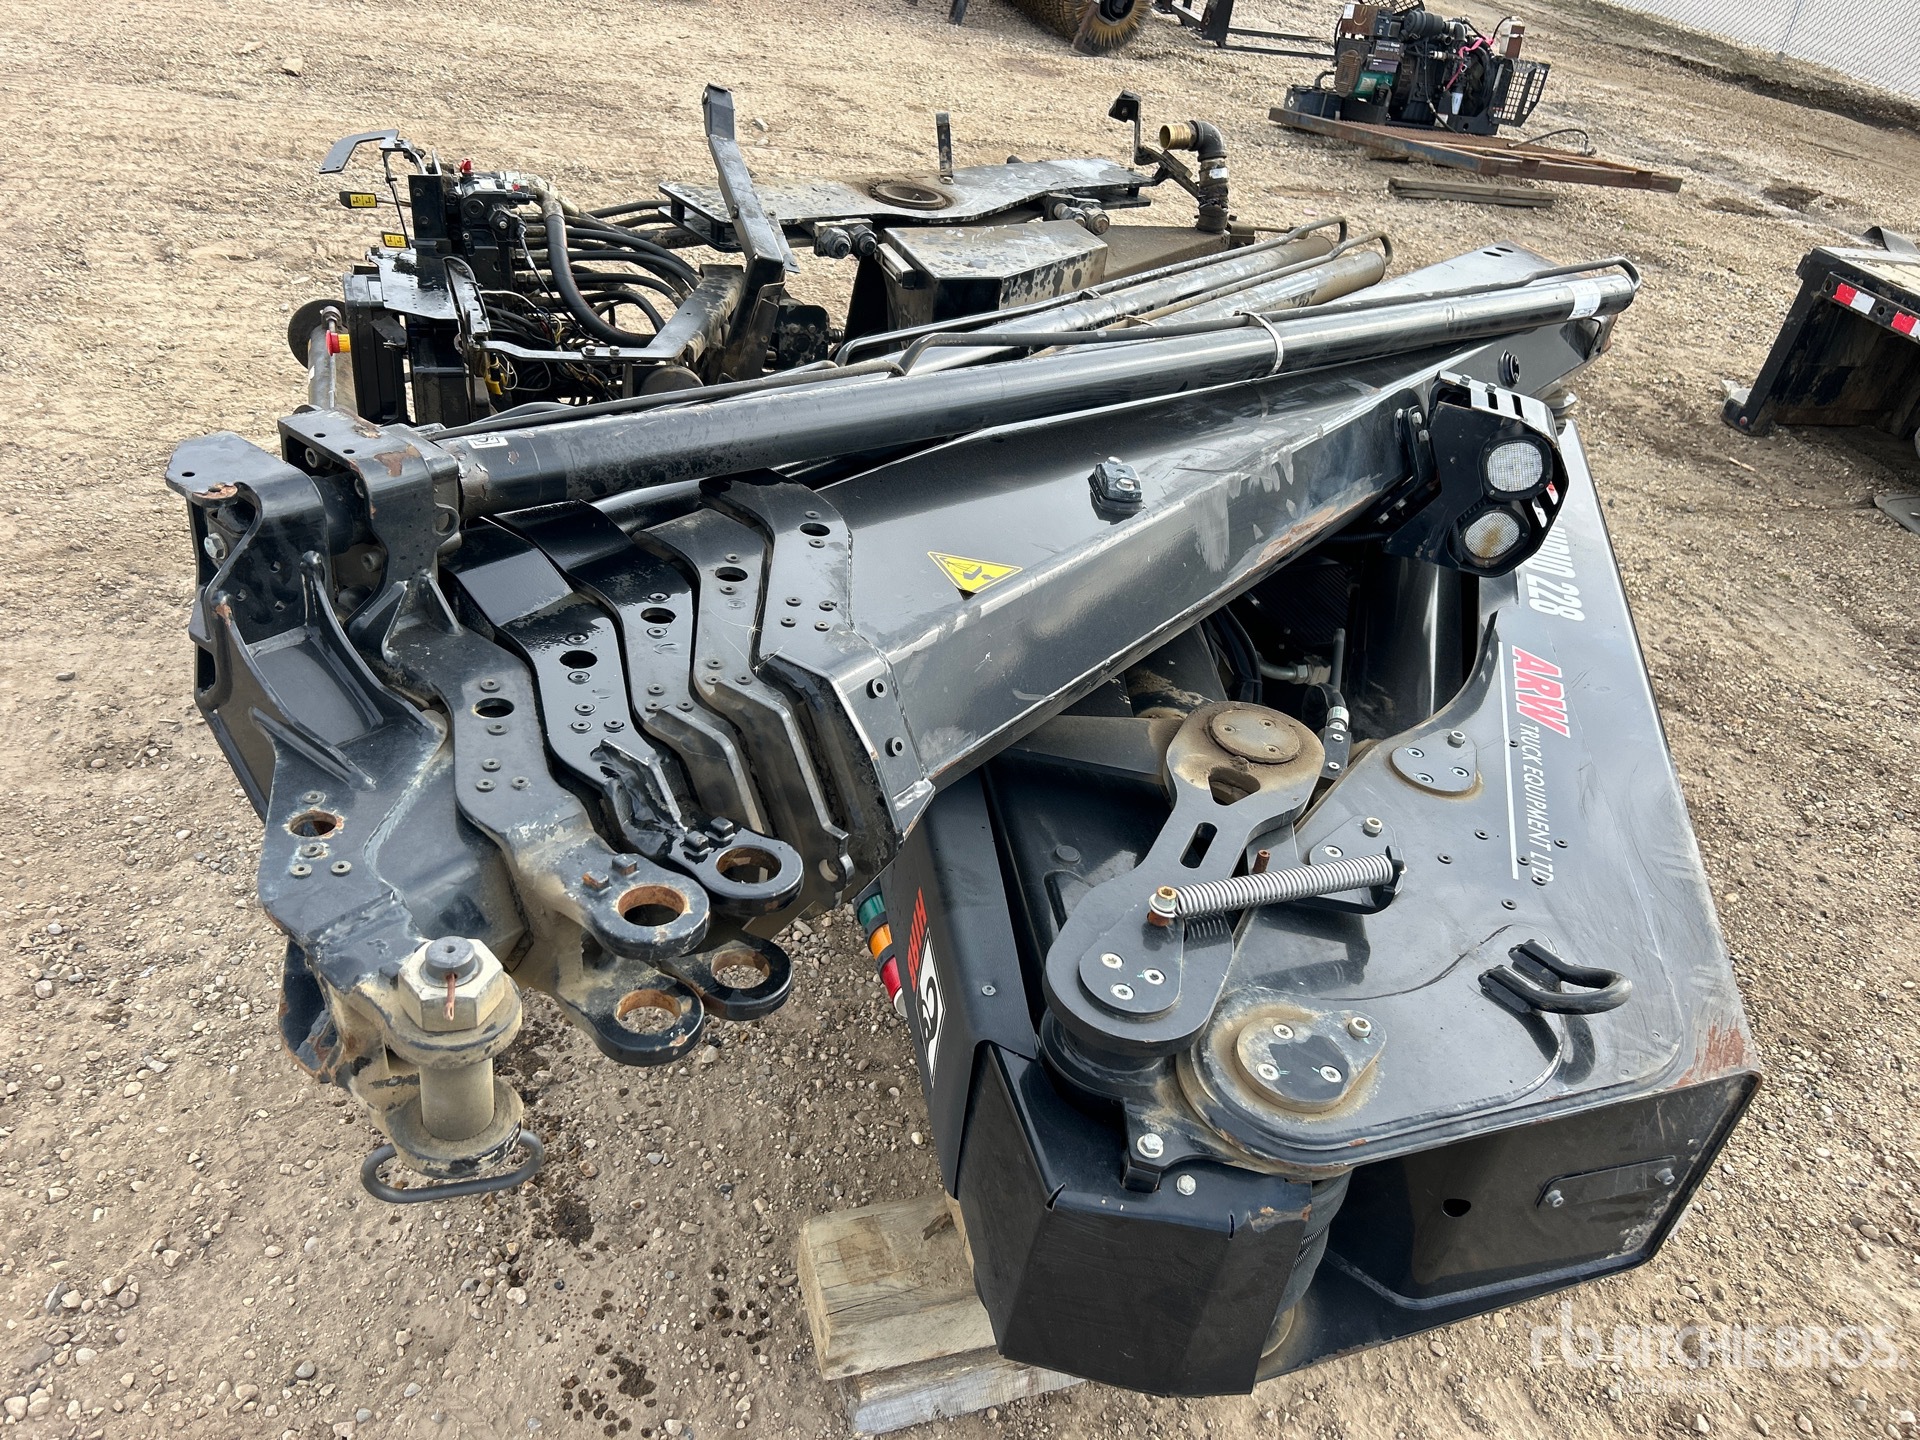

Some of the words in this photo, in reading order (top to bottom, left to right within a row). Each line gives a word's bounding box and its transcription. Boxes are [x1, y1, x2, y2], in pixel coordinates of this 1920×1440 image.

[1525, 572, 1586, 622] 228
[1512, 645, 1571, 738] ARW
[1520, 722, 1543, 766] TRUCK
[1523, 764, 1551, 851] EQUIPMENT
[907, 886, 927, 993] HIAB
